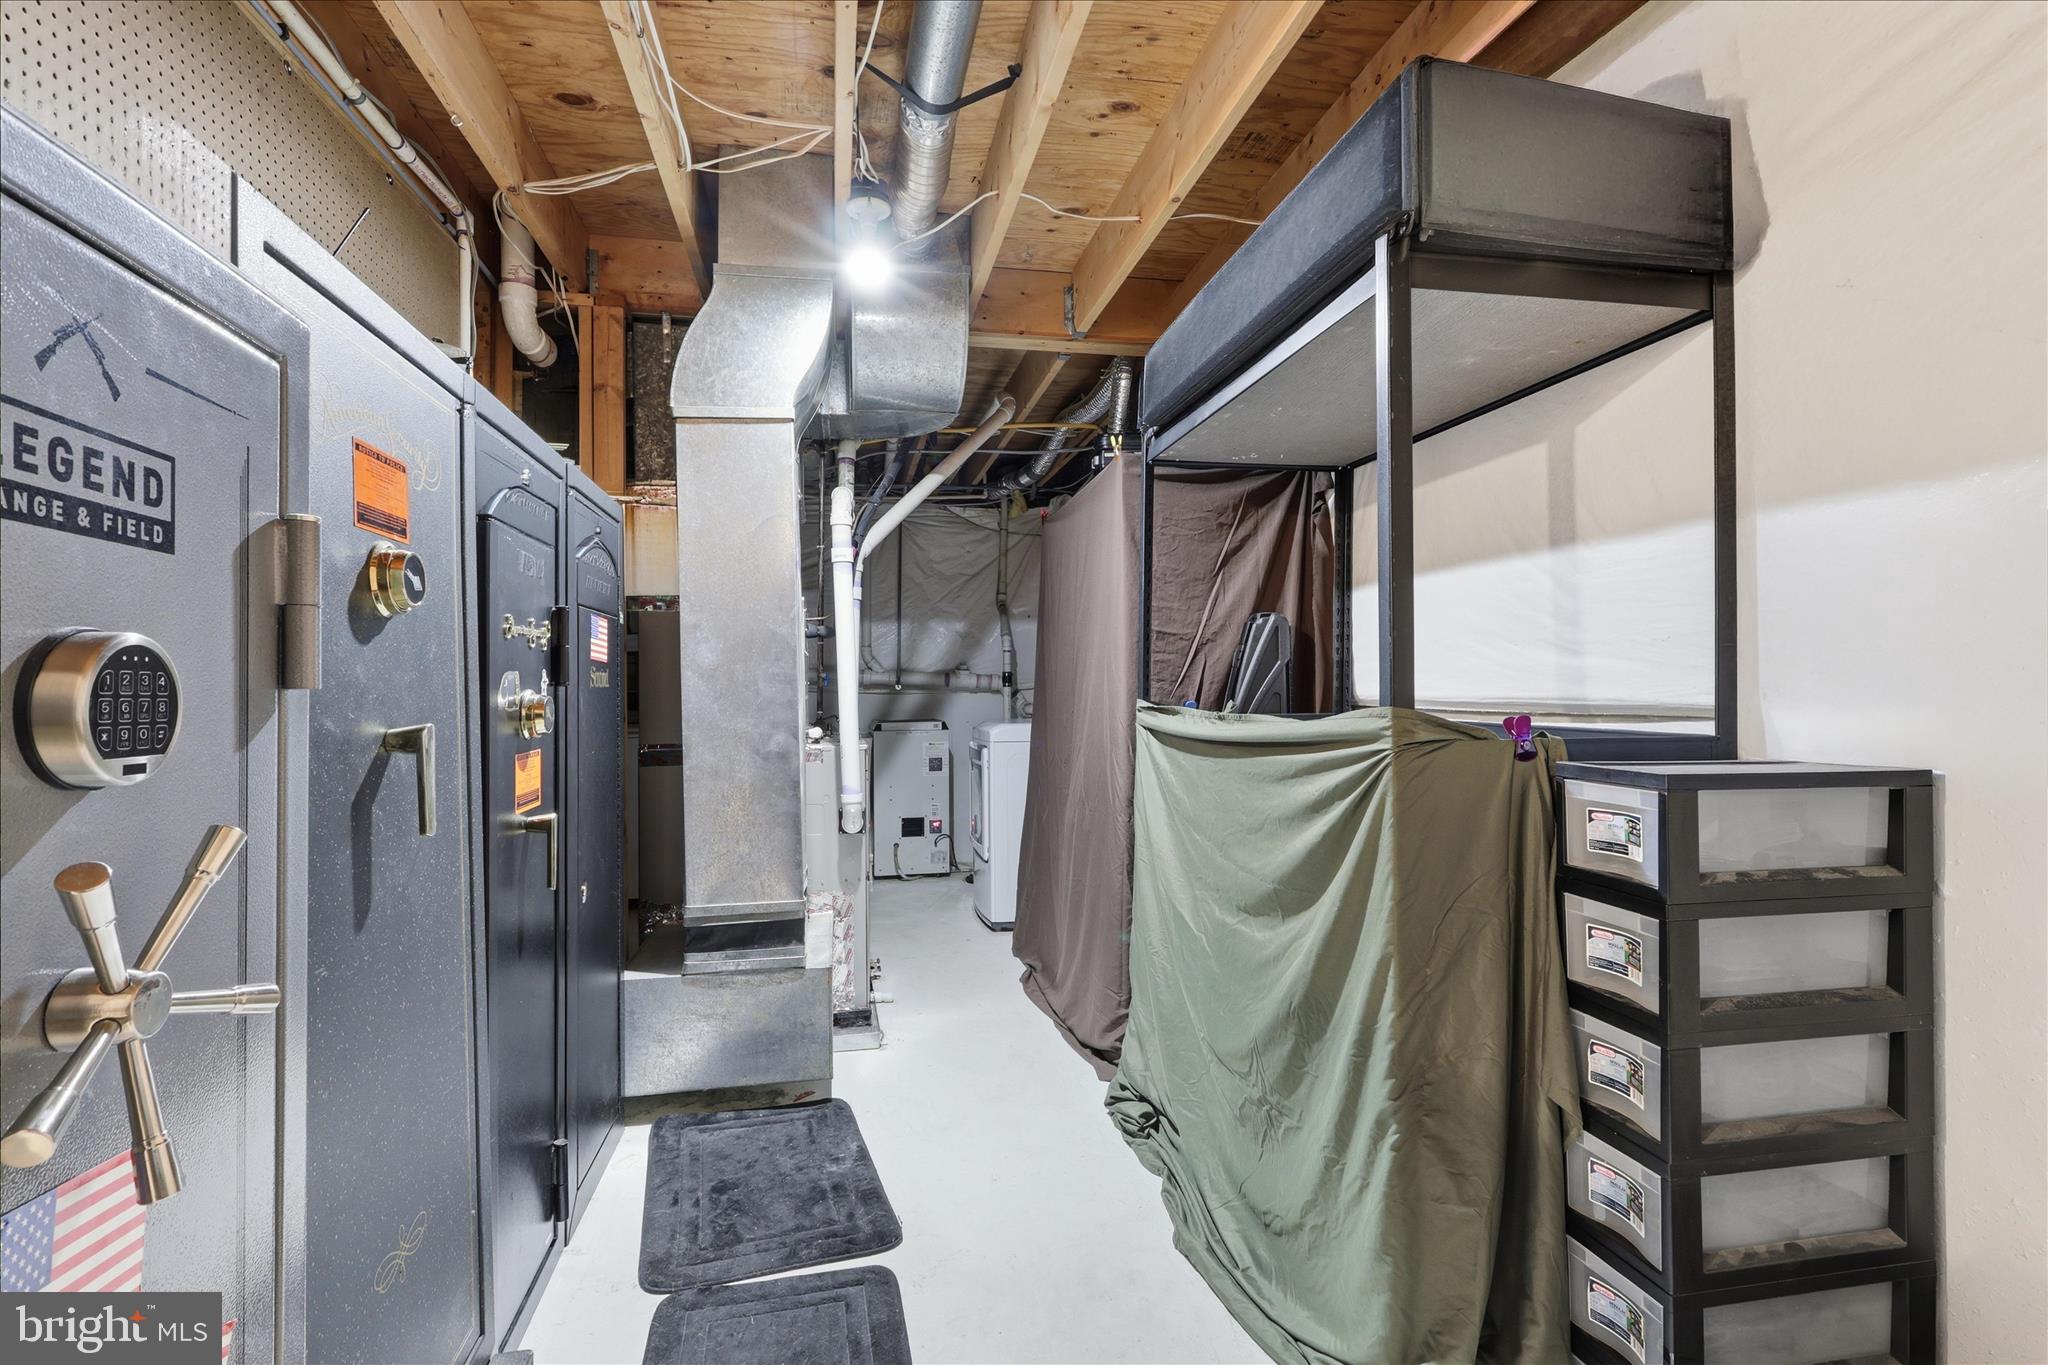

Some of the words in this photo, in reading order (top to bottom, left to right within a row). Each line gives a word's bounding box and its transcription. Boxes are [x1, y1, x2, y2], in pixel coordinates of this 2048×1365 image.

[0, 422, 163, 508] EGEND
[78, 507, 90, 528] &
[103, 512, 163, 544] FIELD
[122, 674, 130, 685] 2
[141, 675, 149, 686] 3
[158, 676, 165, 686] 4
[101, 702, 110, 713] 5
[122, 702, 130, 713] 6
[141, 702, 148, 712] 7
[158, 702, 166, 712] 8
[121, 729, 129, 740] 9
[139, 729, 148, 739] 0
